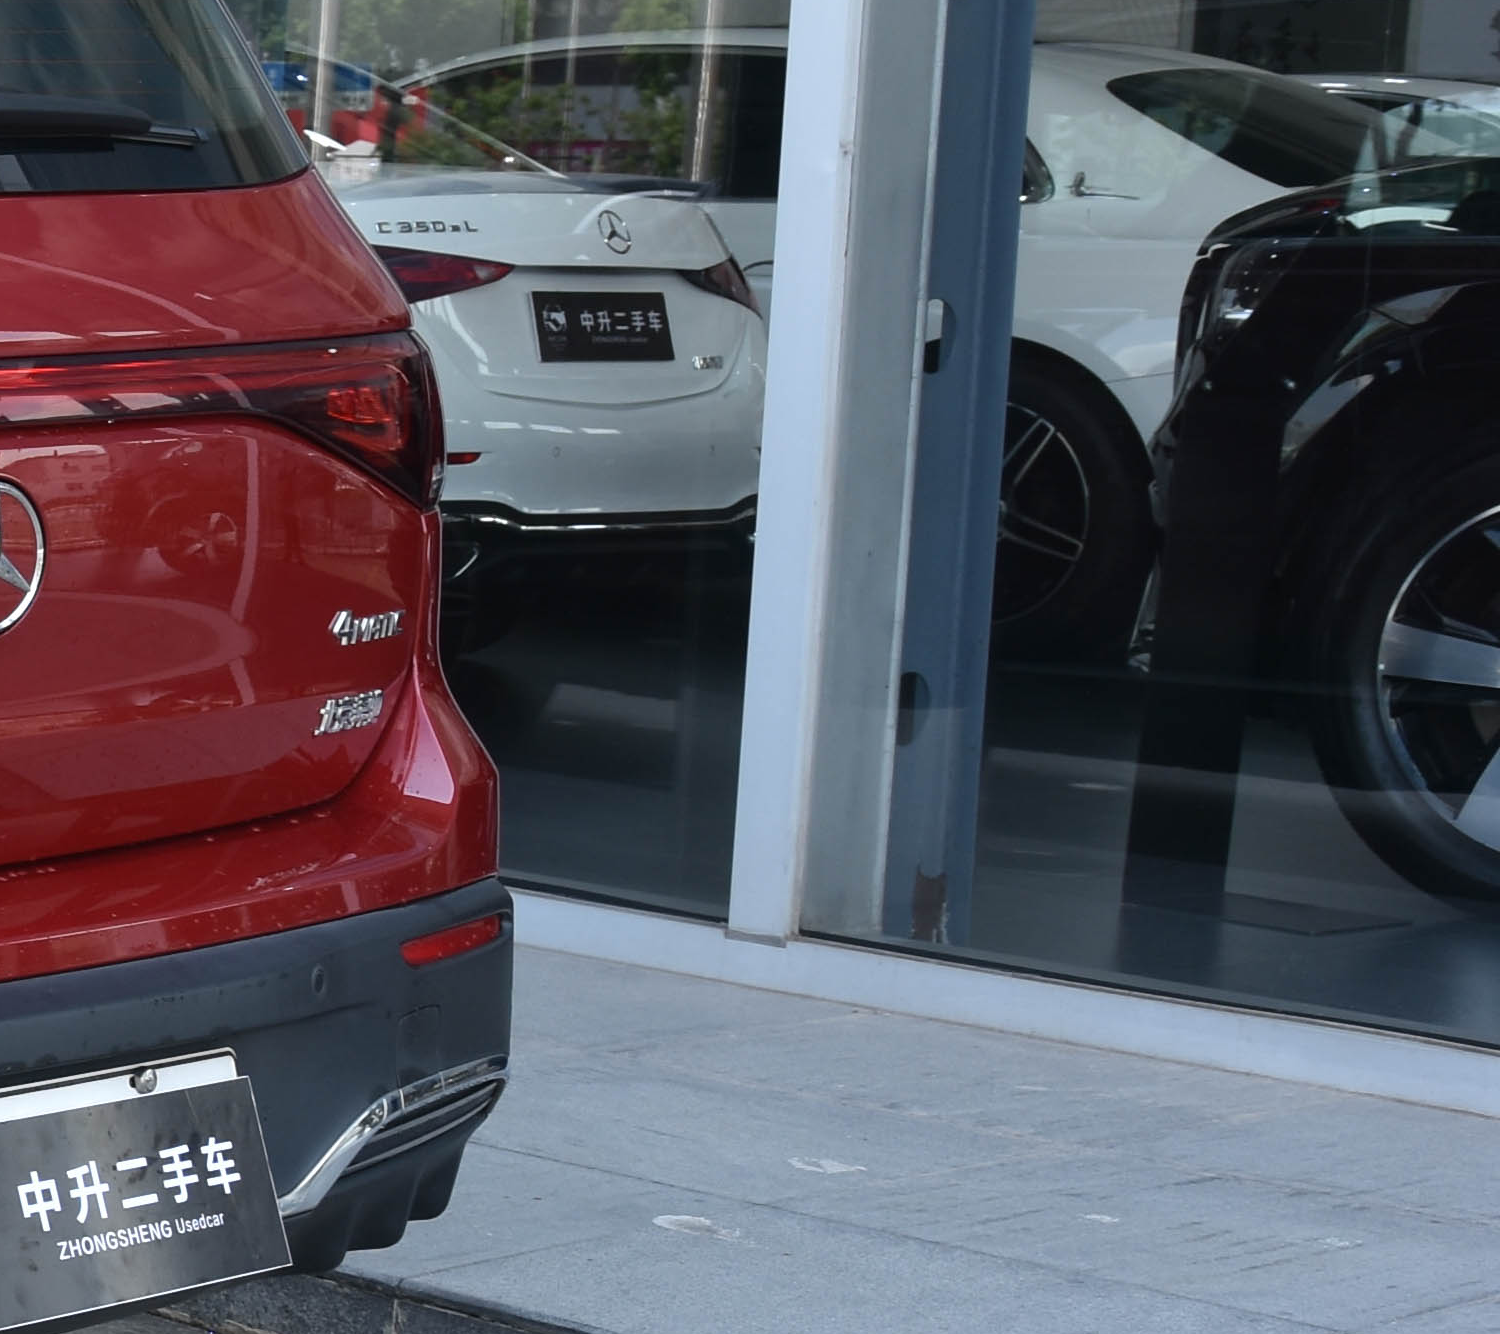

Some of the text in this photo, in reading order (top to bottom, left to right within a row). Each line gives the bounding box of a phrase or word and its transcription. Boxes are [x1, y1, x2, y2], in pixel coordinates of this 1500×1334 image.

[579, 309, 663, 332] 中升二手车
[16, 1136, 243, 1232] 中升二手车
[56, 1211, 226, 1262] ZHONGSHENG Usedcar
